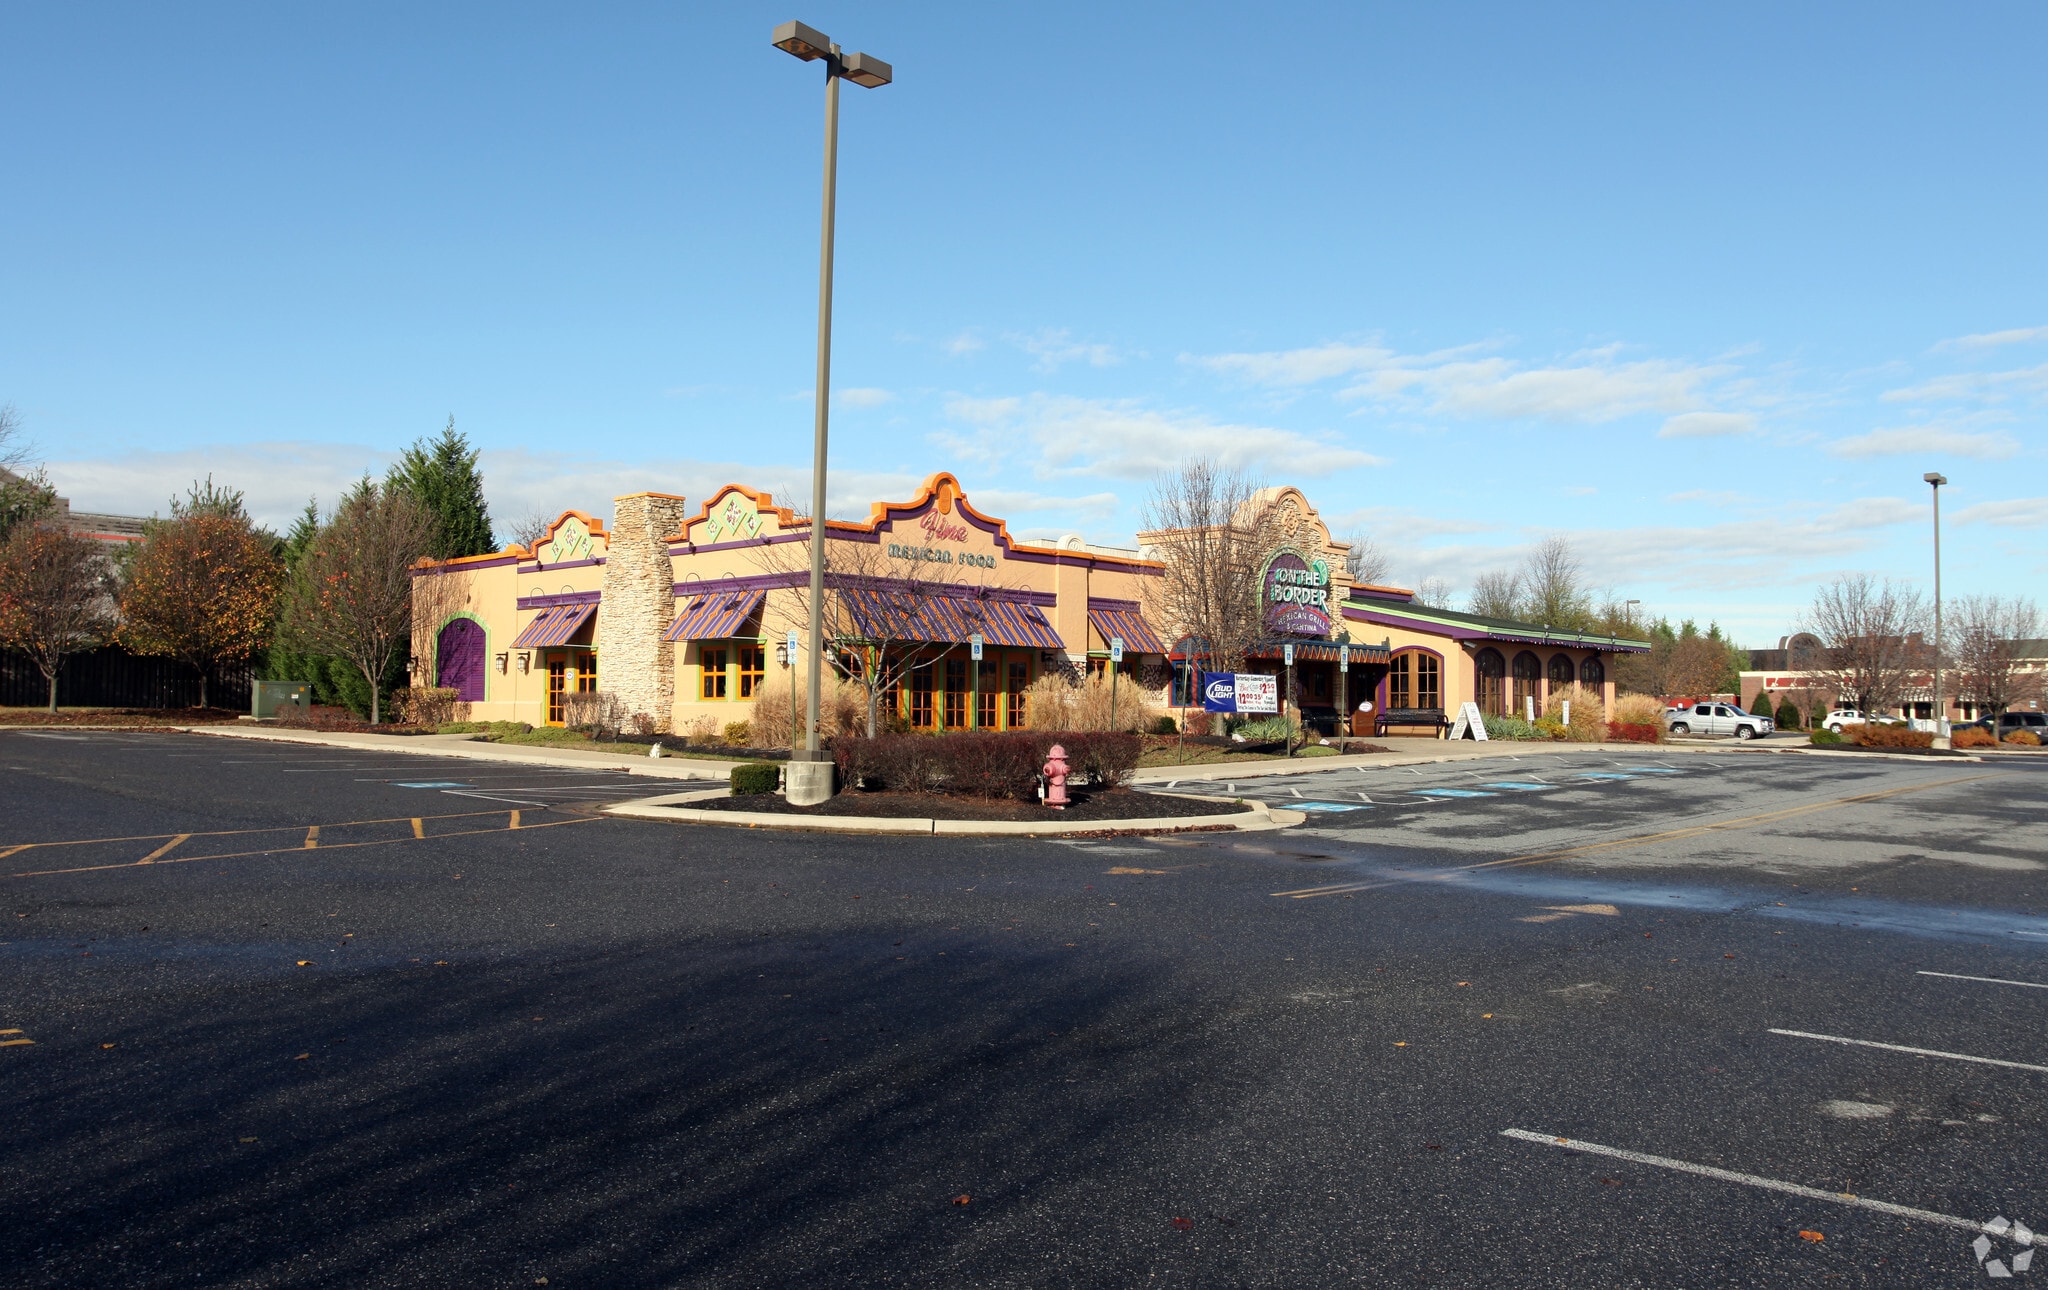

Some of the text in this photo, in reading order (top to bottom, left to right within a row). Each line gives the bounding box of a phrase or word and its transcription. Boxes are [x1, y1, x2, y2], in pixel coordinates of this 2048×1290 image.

[920, 508, 967, 542] Fine
[888, 543, 997, 569] MEXICAN FOOD
[1279, 568, 1320, 586] ON THE
[1274, 584, 1329, 613] BORDER
[1277, 612, 1326, 630] MEXICAN GRILL
[1291, 623, 1317, 632] CANTINA
